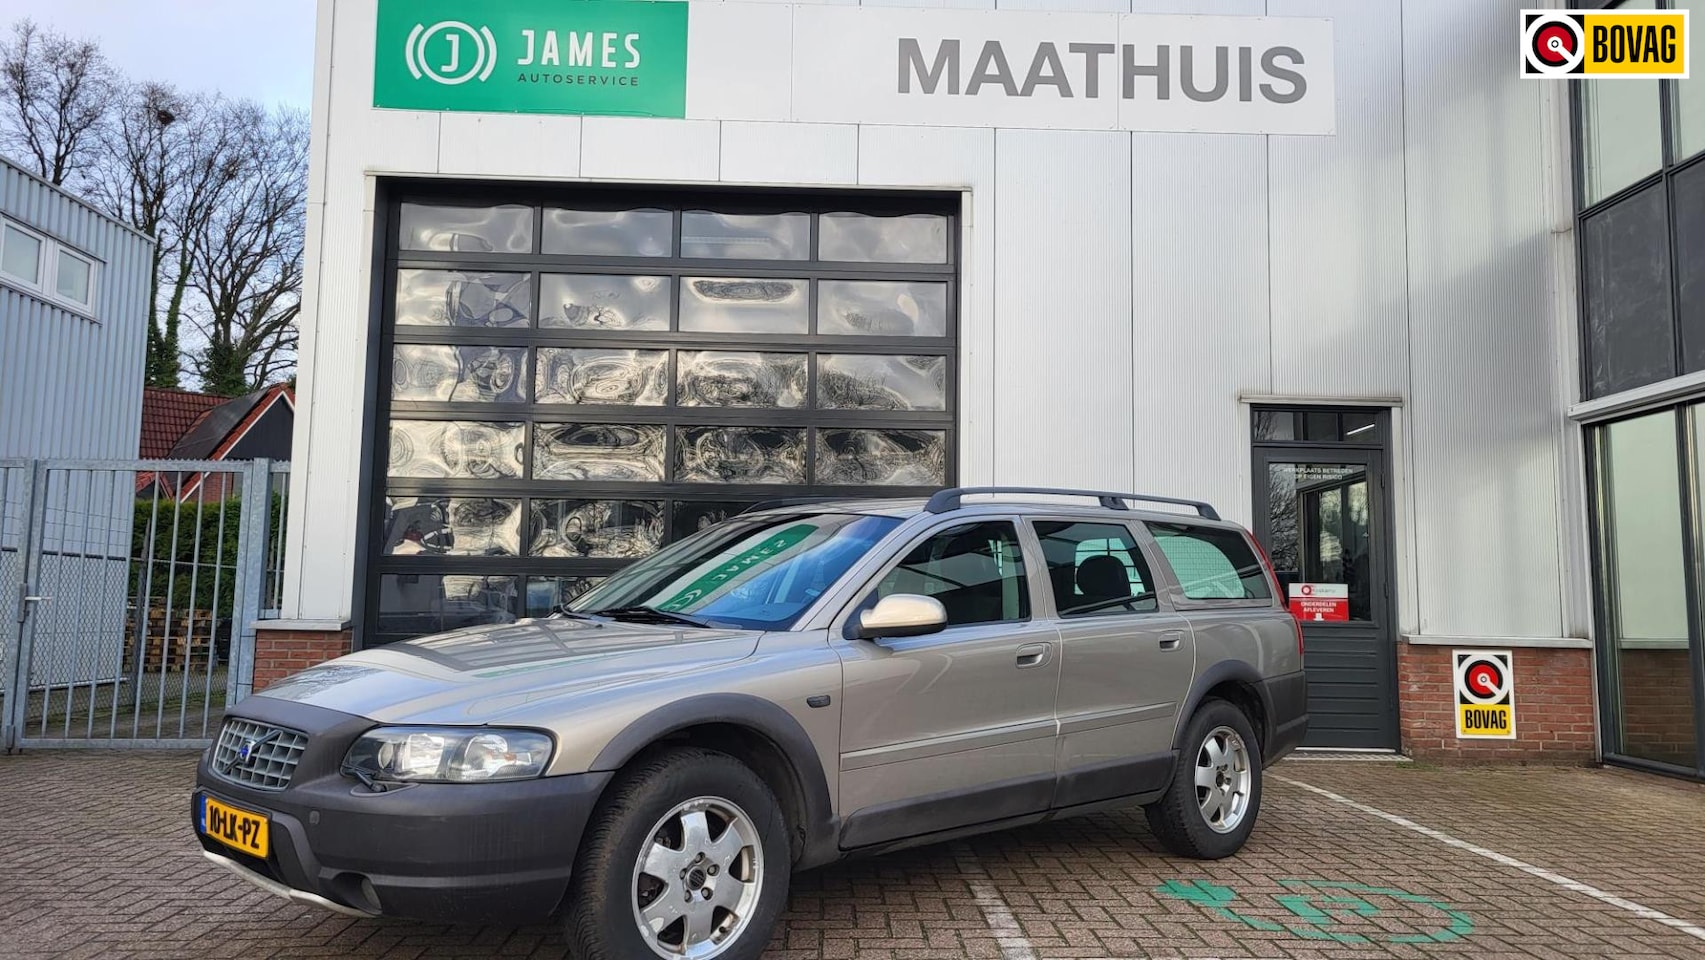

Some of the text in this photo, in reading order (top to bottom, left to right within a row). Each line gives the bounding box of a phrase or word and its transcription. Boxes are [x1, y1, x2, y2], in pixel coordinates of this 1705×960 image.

[517, 29, 640, 69] JAMES
[517, 72, 639, 86] AUTOSERVICE
[898, 37, 1308, 104] MAATHUIS
[1465, 709, 1507, 729] BOVAG
[209, 805, 260, 849] 10-LK-PZ
